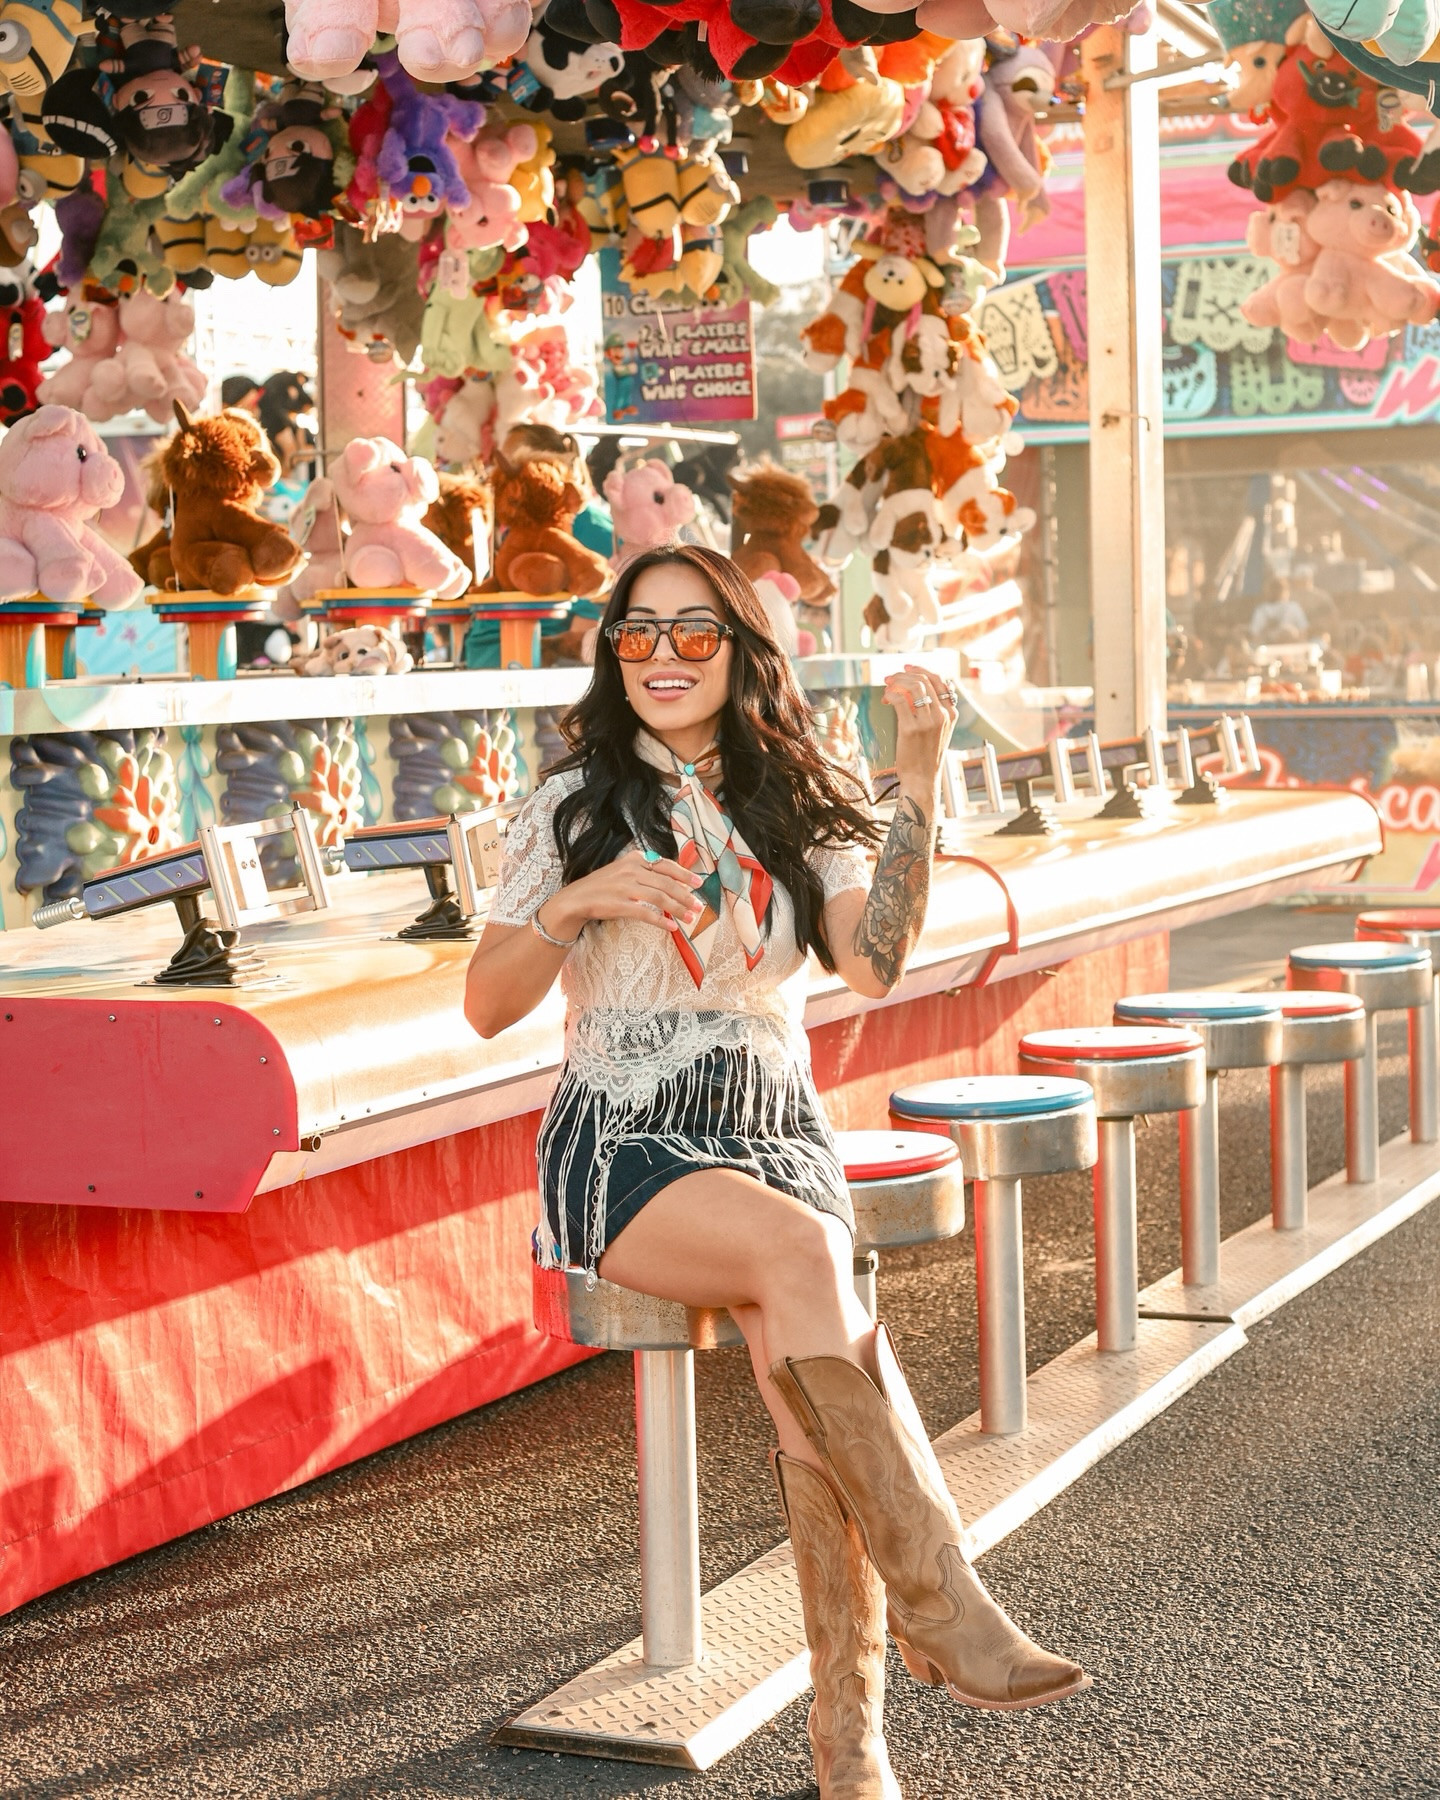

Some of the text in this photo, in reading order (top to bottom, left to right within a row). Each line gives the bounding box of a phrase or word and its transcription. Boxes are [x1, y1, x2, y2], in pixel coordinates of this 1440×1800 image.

[673, 322, 747, 341] PLAYERS
[640, 338, 750, 358] WINS SMALL
[675, 361, 746, 381] PLAYERS
[641, 380, 752, 401] WINS CHOICE
